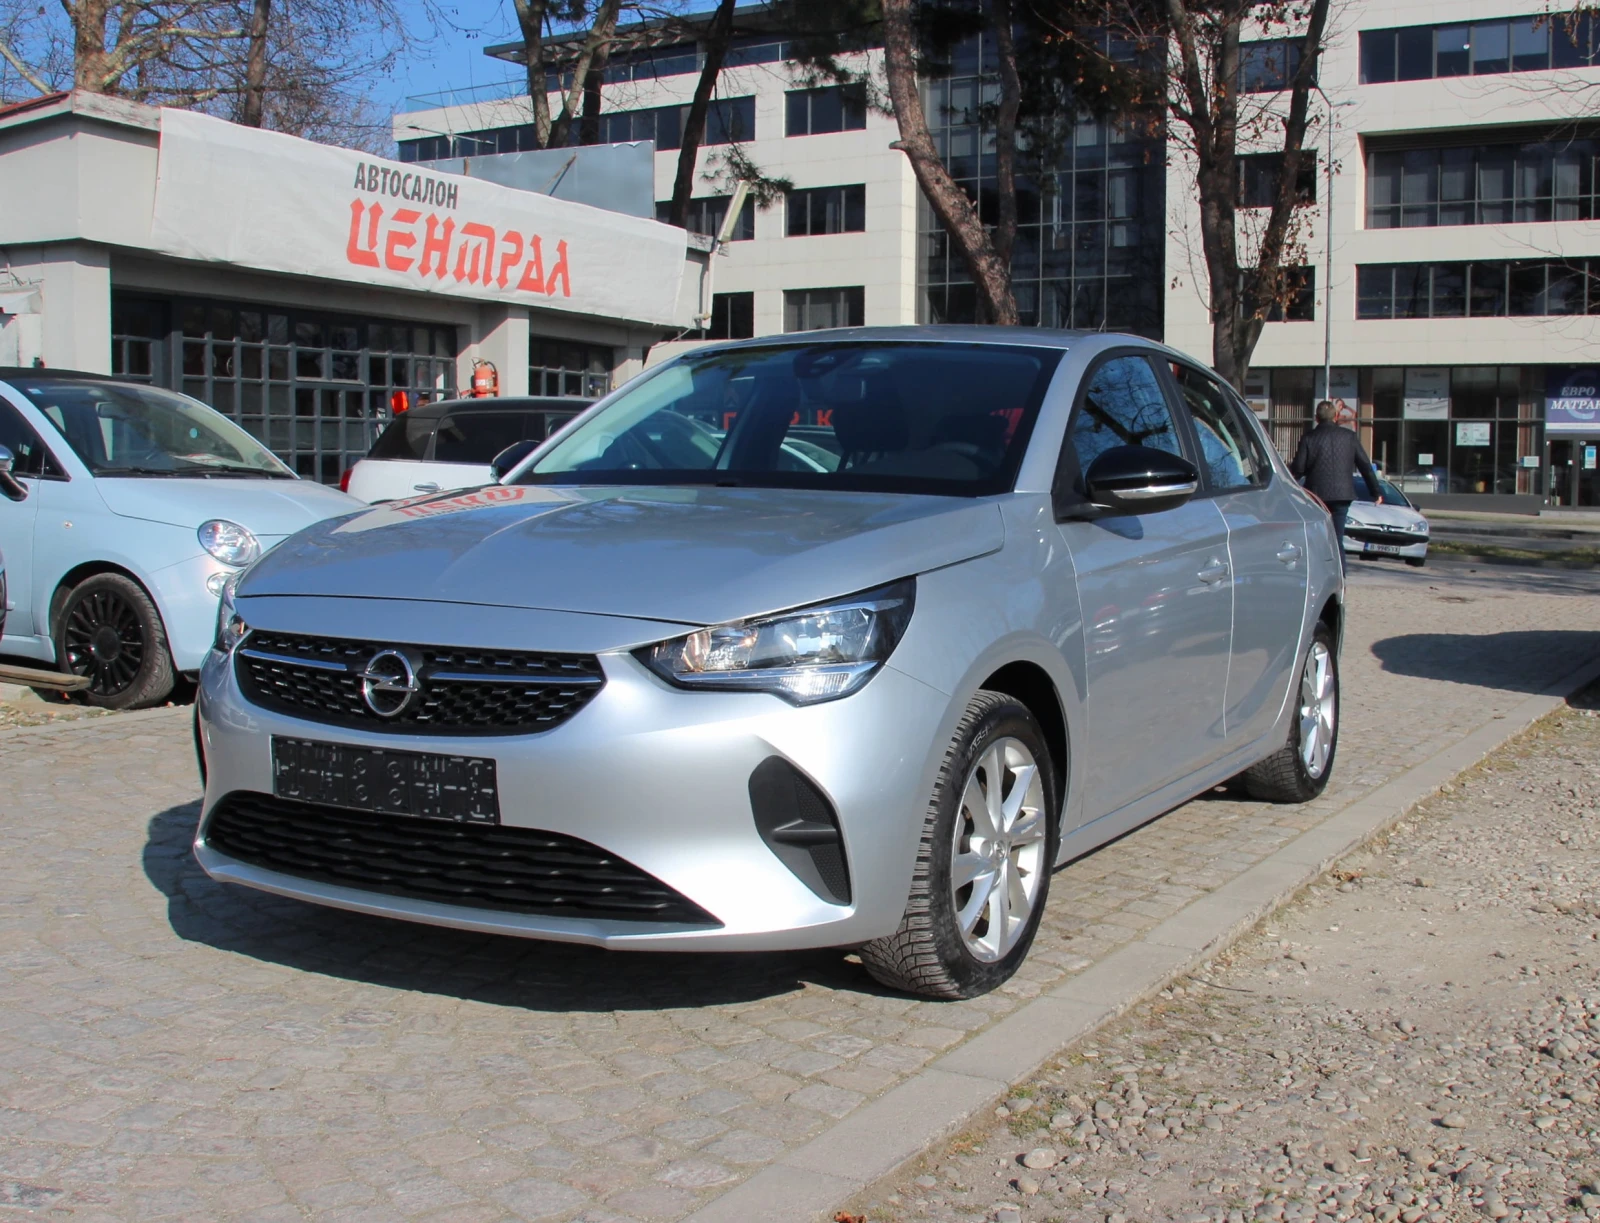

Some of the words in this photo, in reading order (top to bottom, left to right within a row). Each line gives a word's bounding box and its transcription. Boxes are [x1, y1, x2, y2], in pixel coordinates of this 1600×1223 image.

[354, 161, 459, 210] АВТОСАЛОН
[346, 198, 570, 297] ЦЕНТРАЛ
[1561, 386, 1596, 396] ЕВРО
